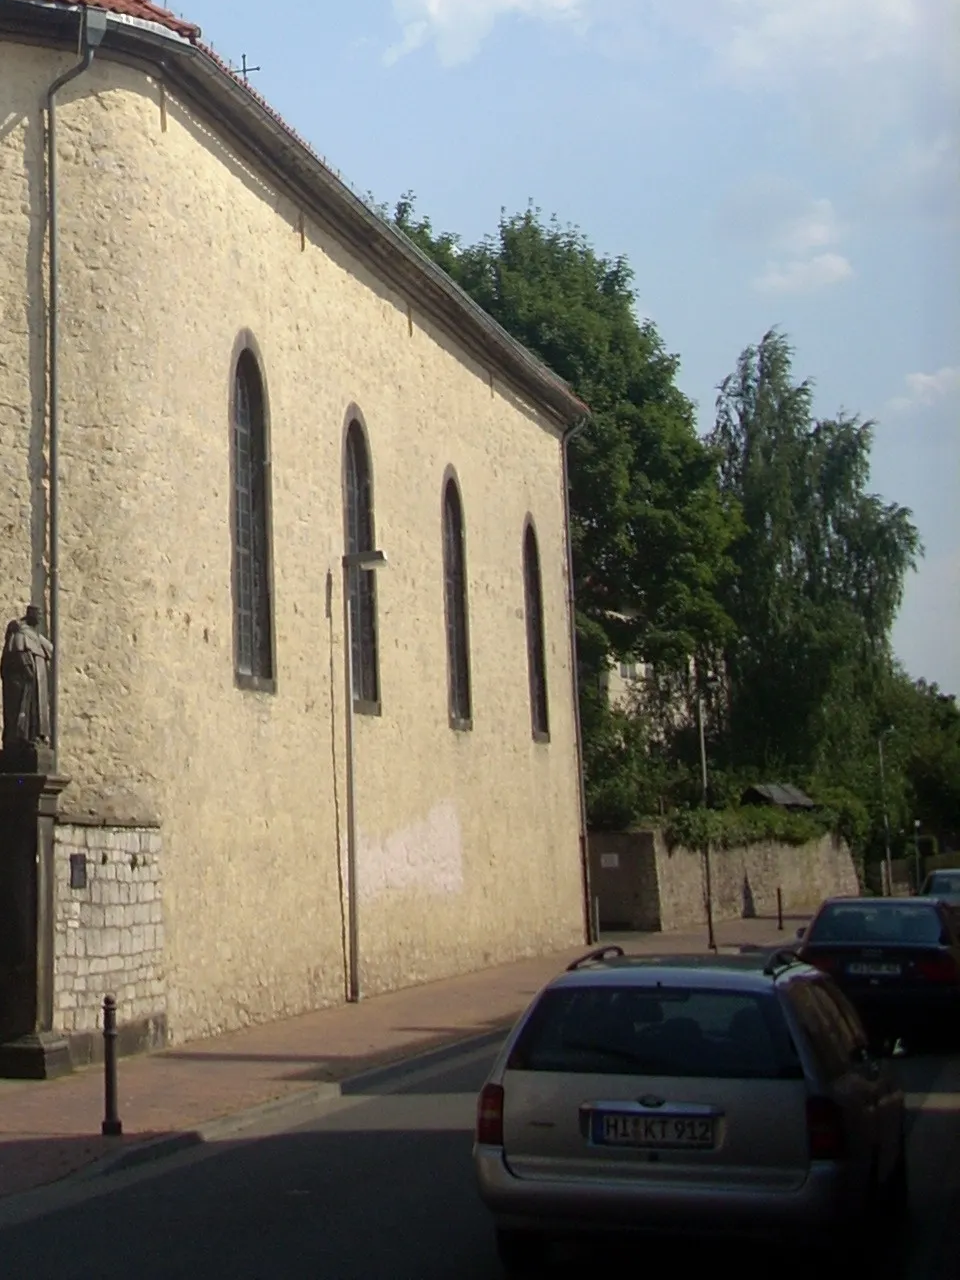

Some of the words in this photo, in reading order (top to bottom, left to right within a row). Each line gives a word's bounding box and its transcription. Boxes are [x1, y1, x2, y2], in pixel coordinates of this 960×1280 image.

[605, 1117, 629, 1137] HI
[644, 1119, 668, 1139] KT
[675, 1120, 710, 1141] 912
